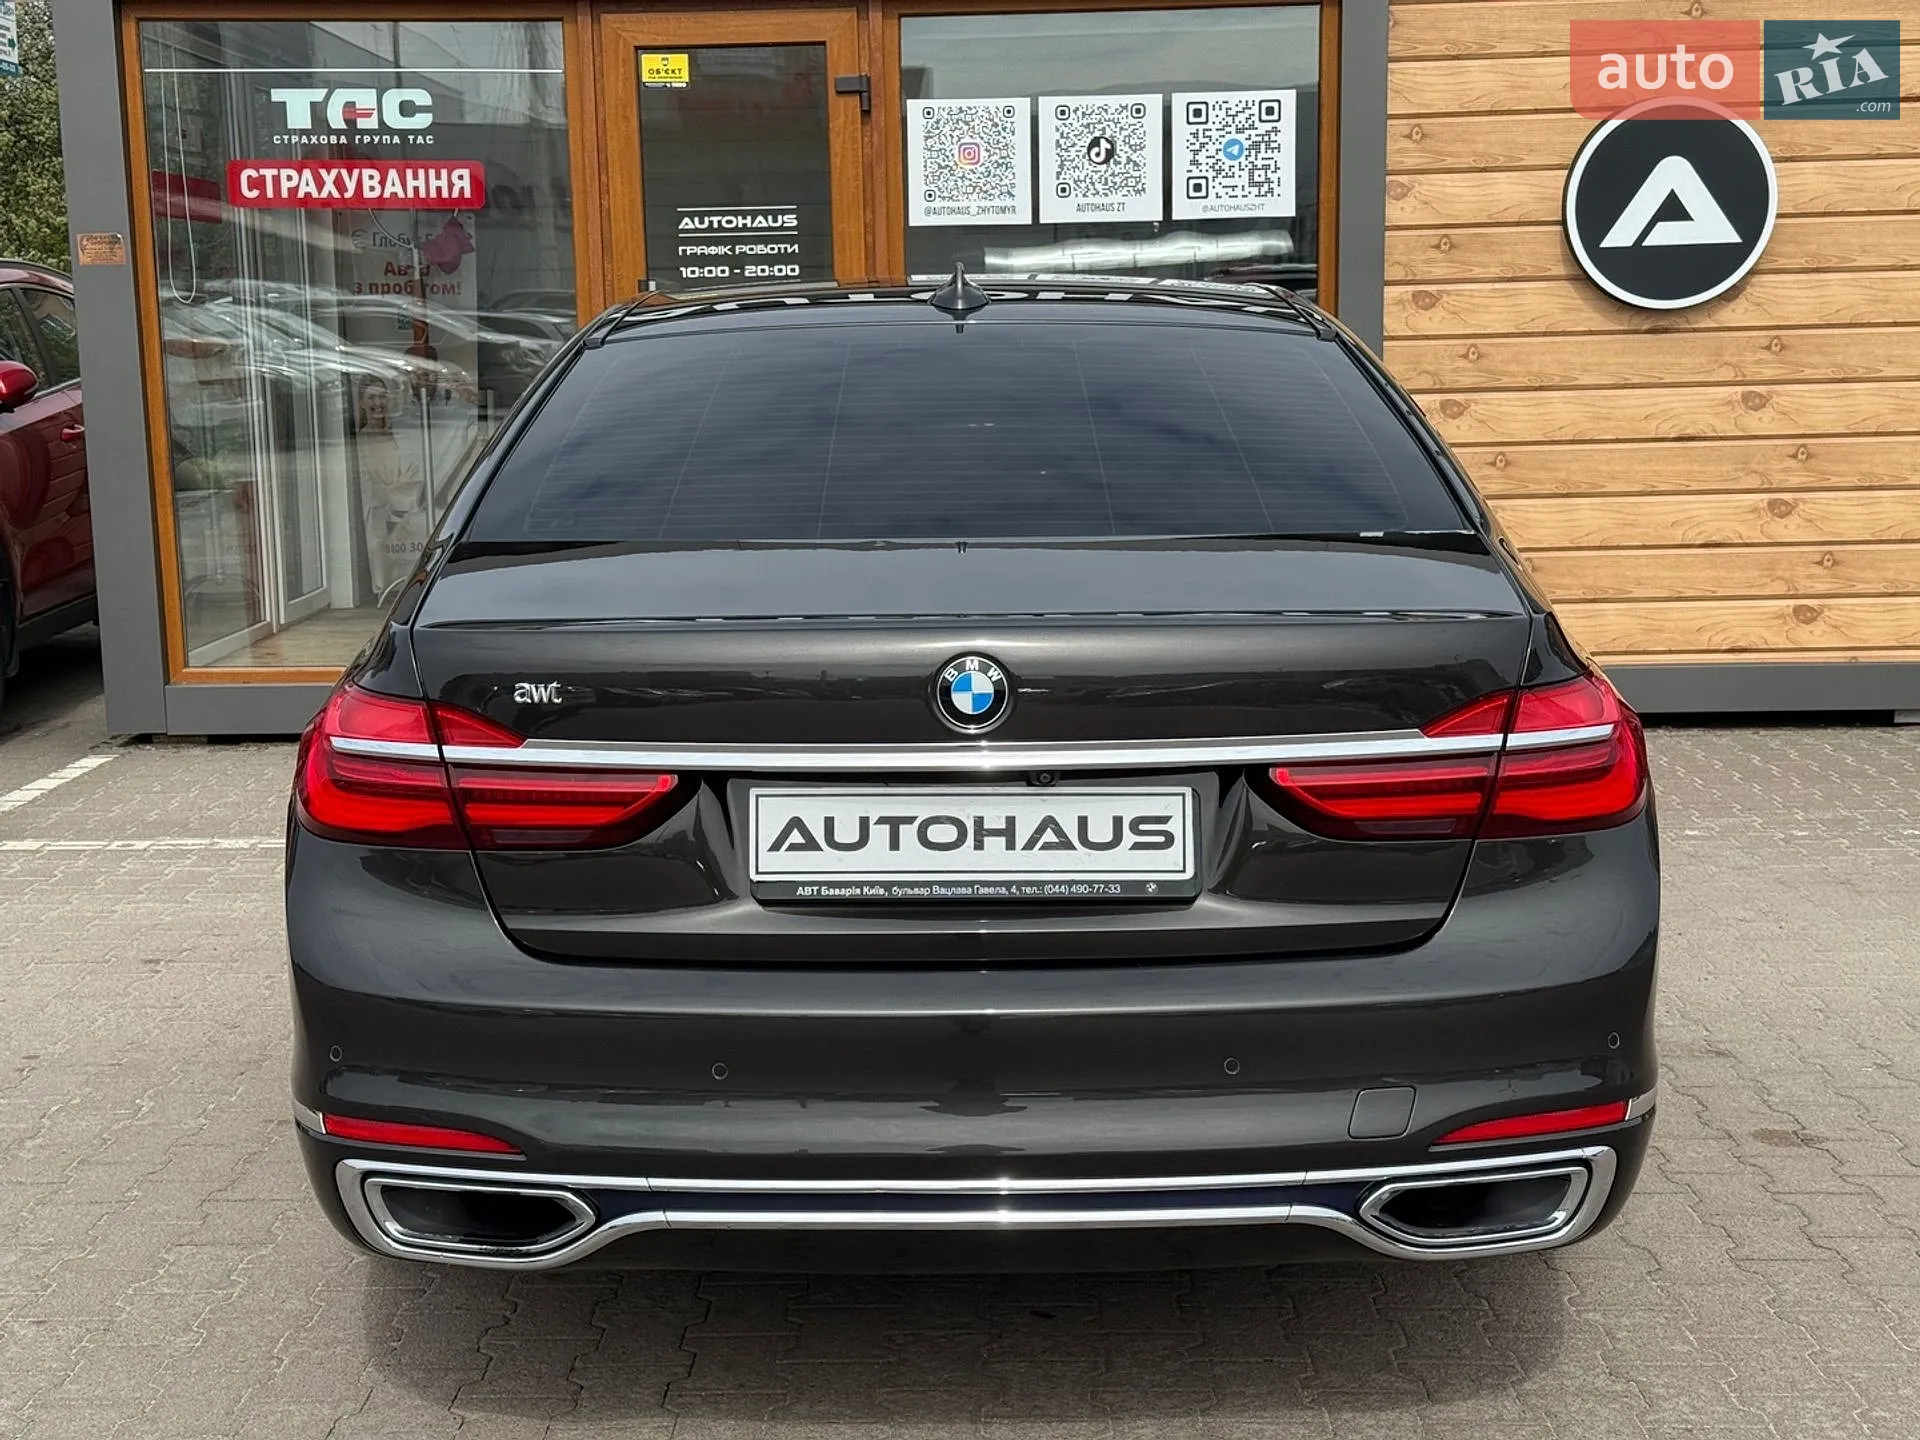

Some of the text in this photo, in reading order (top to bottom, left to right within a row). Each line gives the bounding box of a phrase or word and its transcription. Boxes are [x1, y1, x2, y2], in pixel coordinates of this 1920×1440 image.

[270, 88, 433, 129] ТАС
[273, 135, 434, 144] СТРАХОВА ГРУПА ТАС
[240, 168, 472, 199] СТРАХУВАННЯ
[1076, 202, 1116, 213] AUTOHAUS
[678, 214, 798, 230] AUTOHAUS
[678, 244, 799, 256] ГРАФІК РОБОТИ
[680, 266, 730, 278] 10:00
[744, 264, 800, 277] 20:00
[944, 659, 1002, 682] BMW
[513, 680, 562, 704] awt
[766, 815, 1176, 852] AUTOHAUS
[821, 886, 860, 897] Баварія
[862, 885, 888, 896] Київ,
[891, 885, 930, 896] бульвар
[932, 885, 972, 896] Вацлава
[1044, 884, 1069, 895] (044)
[1070, 884, 1121, 894] 490-77-33
